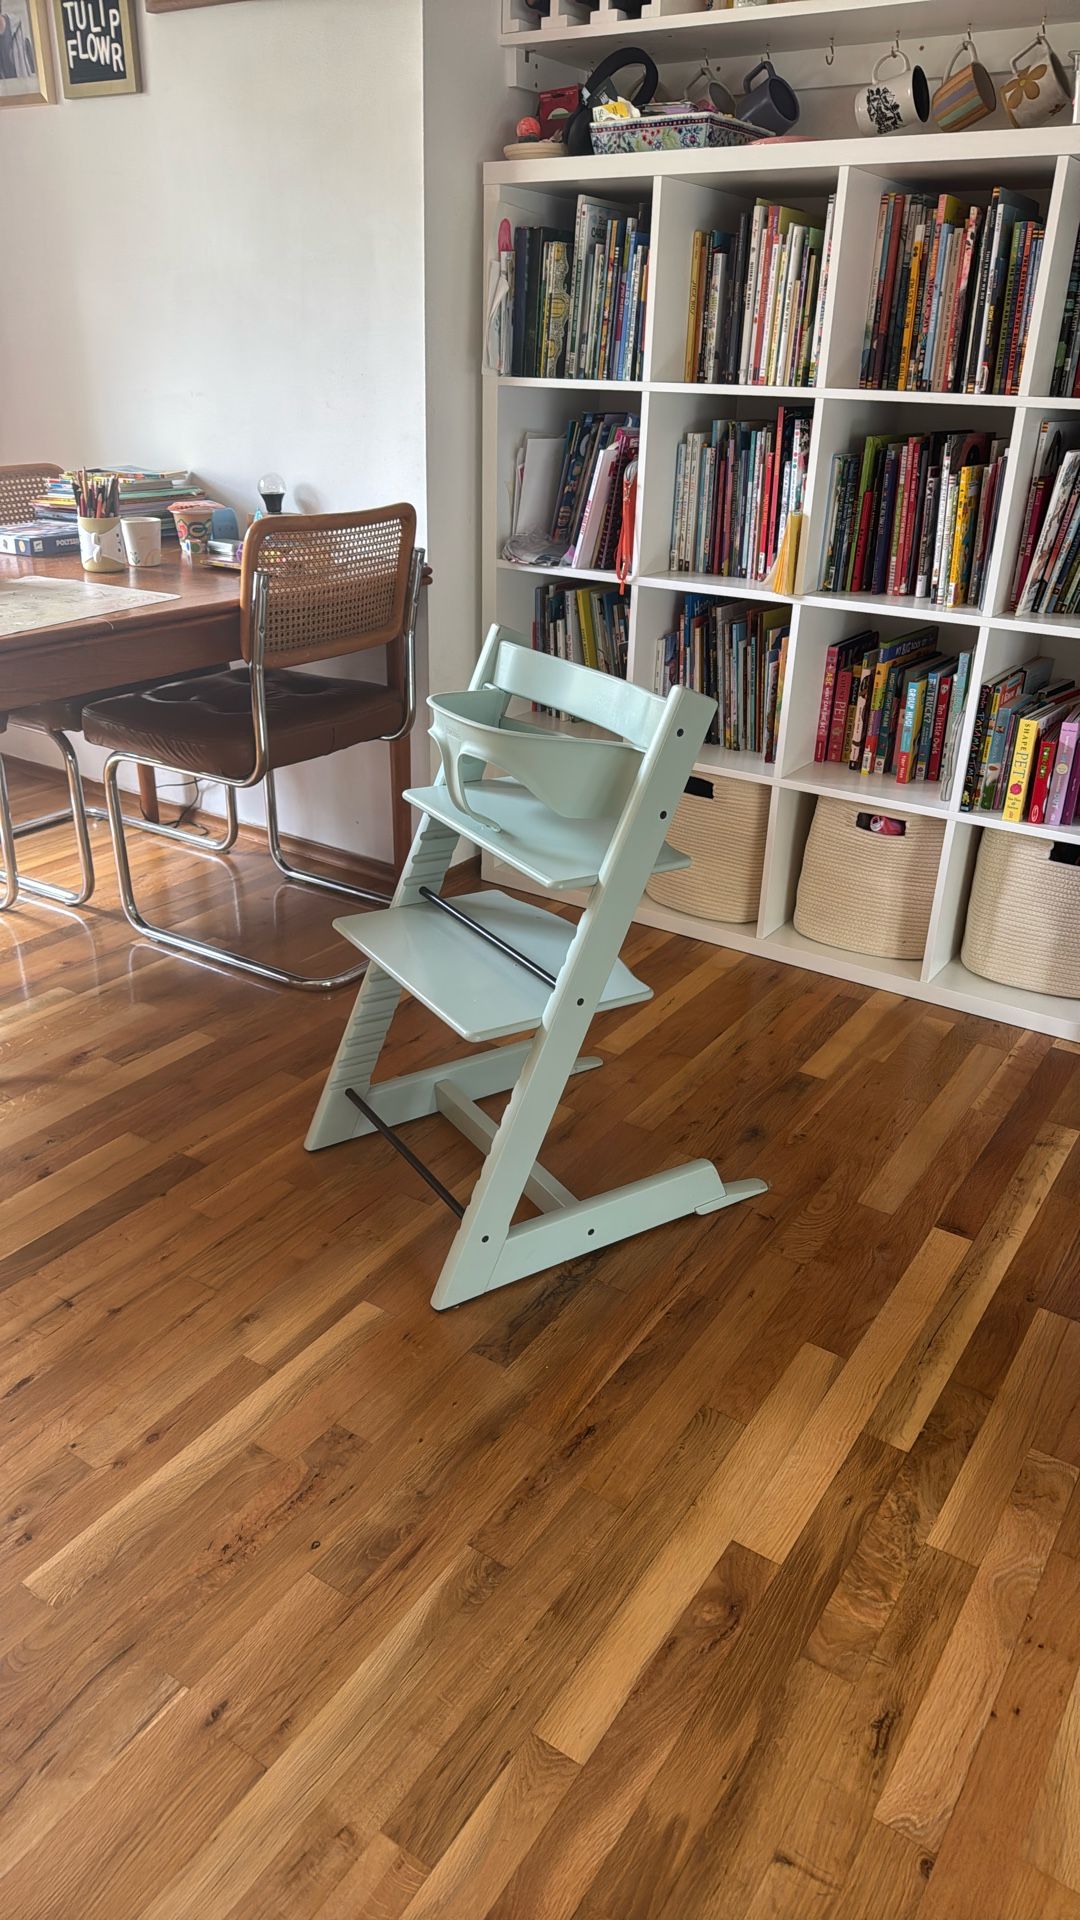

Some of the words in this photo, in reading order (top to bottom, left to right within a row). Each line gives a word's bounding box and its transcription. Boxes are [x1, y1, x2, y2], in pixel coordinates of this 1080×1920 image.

[63, 0, 121, 39] TULIP
[66, 30, 124, 73] FLOWR
[906, 688, 916, 709] GROUP
[936, 702, 945, 715] Ten
[832, 701, 846, 724] PET
[904, 711, 913, 726] HUG!
[934, 717, 943, 735] little
[970, 710, 984, 751] PAJAMA
[1020, 723, 1030, 751] SHAPE
[964, 759, 976, 786] TIME!
[1011, 751, 1028, 779] PET
